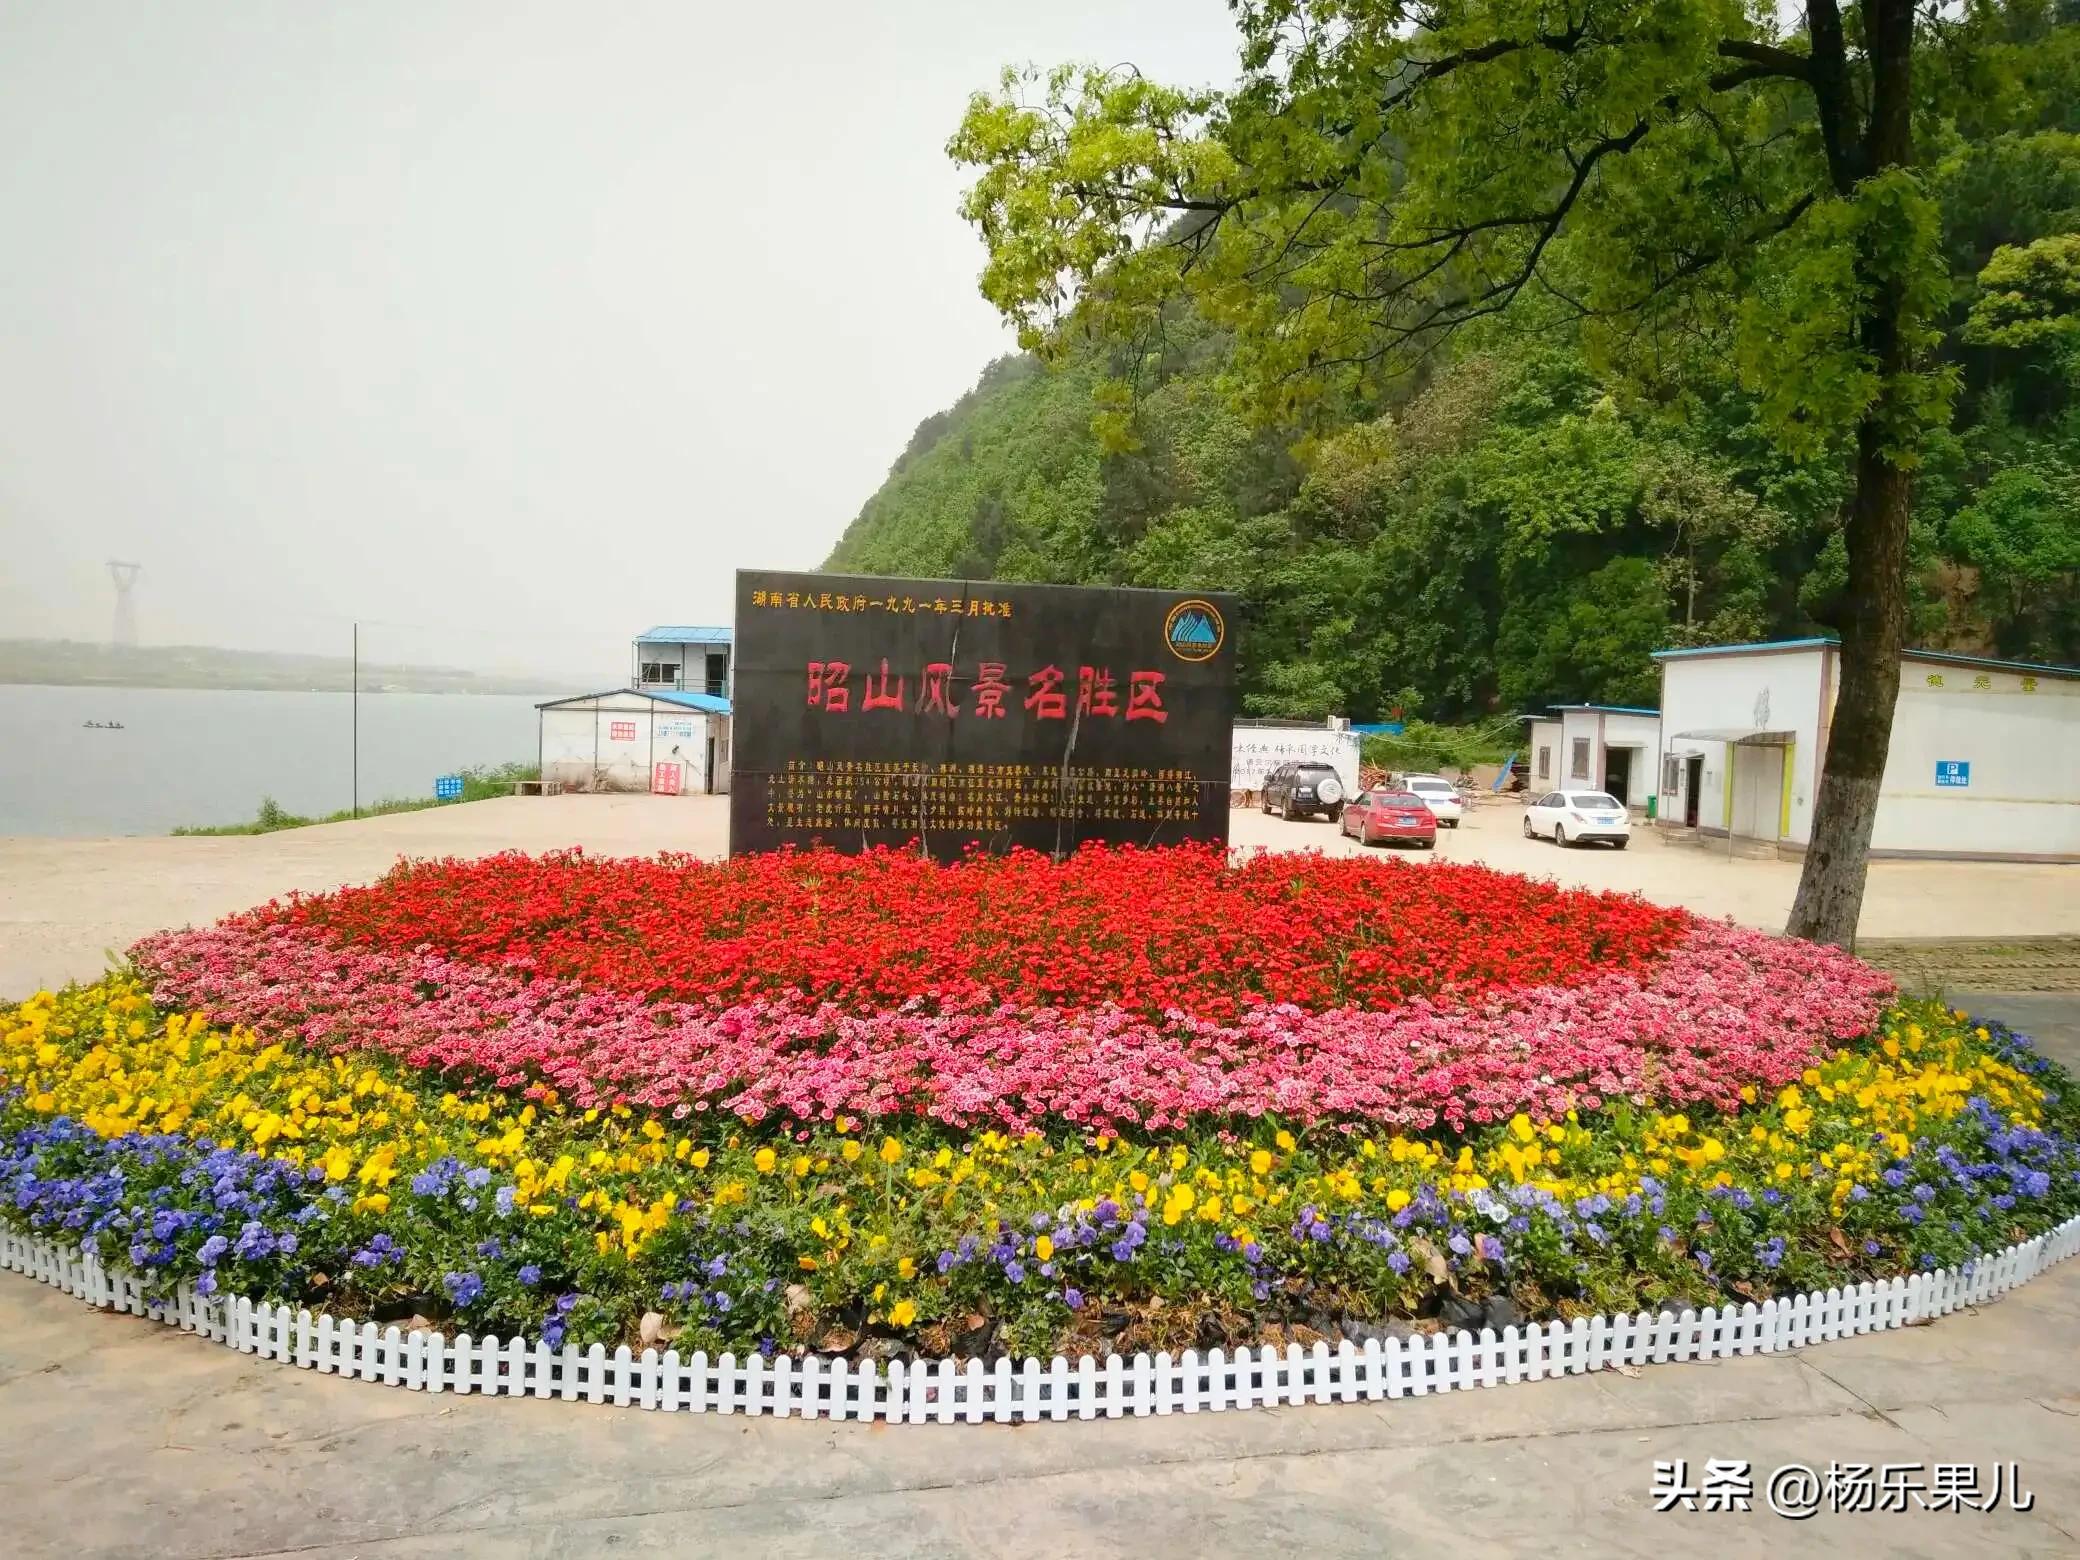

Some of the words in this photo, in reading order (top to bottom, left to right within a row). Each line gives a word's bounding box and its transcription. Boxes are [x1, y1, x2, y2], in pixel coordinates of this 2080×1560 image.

[752, 590, 1013, 618] 湖南省人民政府一九九一年三月批准
[806, 657, 1168, 723] 昭山风景名胜区
